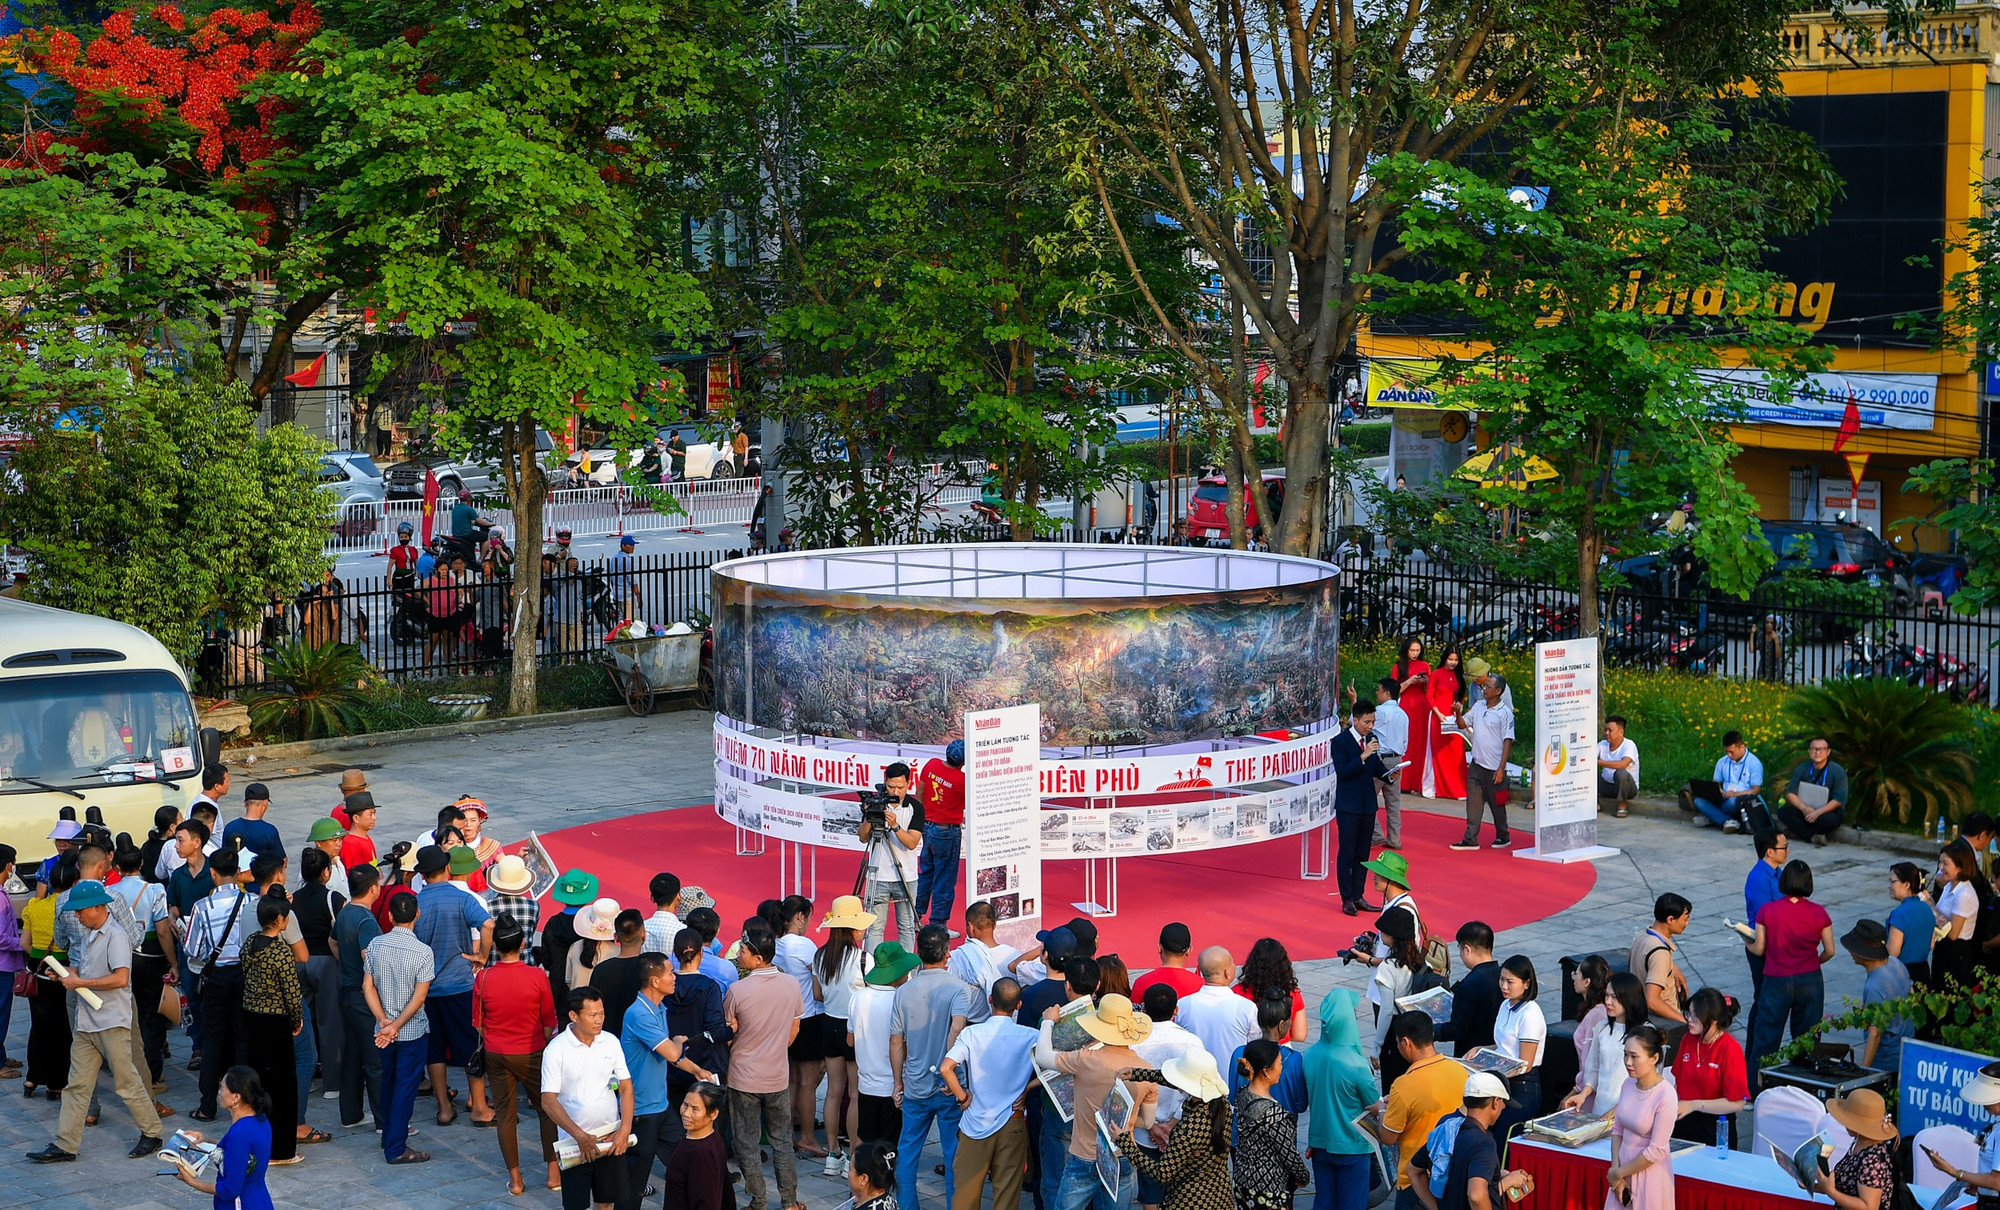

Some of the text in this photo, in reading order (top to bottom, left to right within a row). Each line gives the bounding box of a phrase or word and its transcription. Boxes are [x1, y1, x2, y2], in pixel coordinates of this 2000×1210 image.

[1852, 389, 1929, 405] 22990.000
[174, 757, 184, 769] B
[751, 746, 765, 771] 70
[770, 748, 806, 780] NĂM
[813, 754, 869, 787] CHIẾN
[1225, 757, 1256, 783] THE
[1096, 762, 1139, 792] PHỦ
[1917, 1060, 1948, 1084] QUÝ
[1908, 1085, 1929, 1111] TỰ
[1931, 1089, 1963, 1116] BẢO
